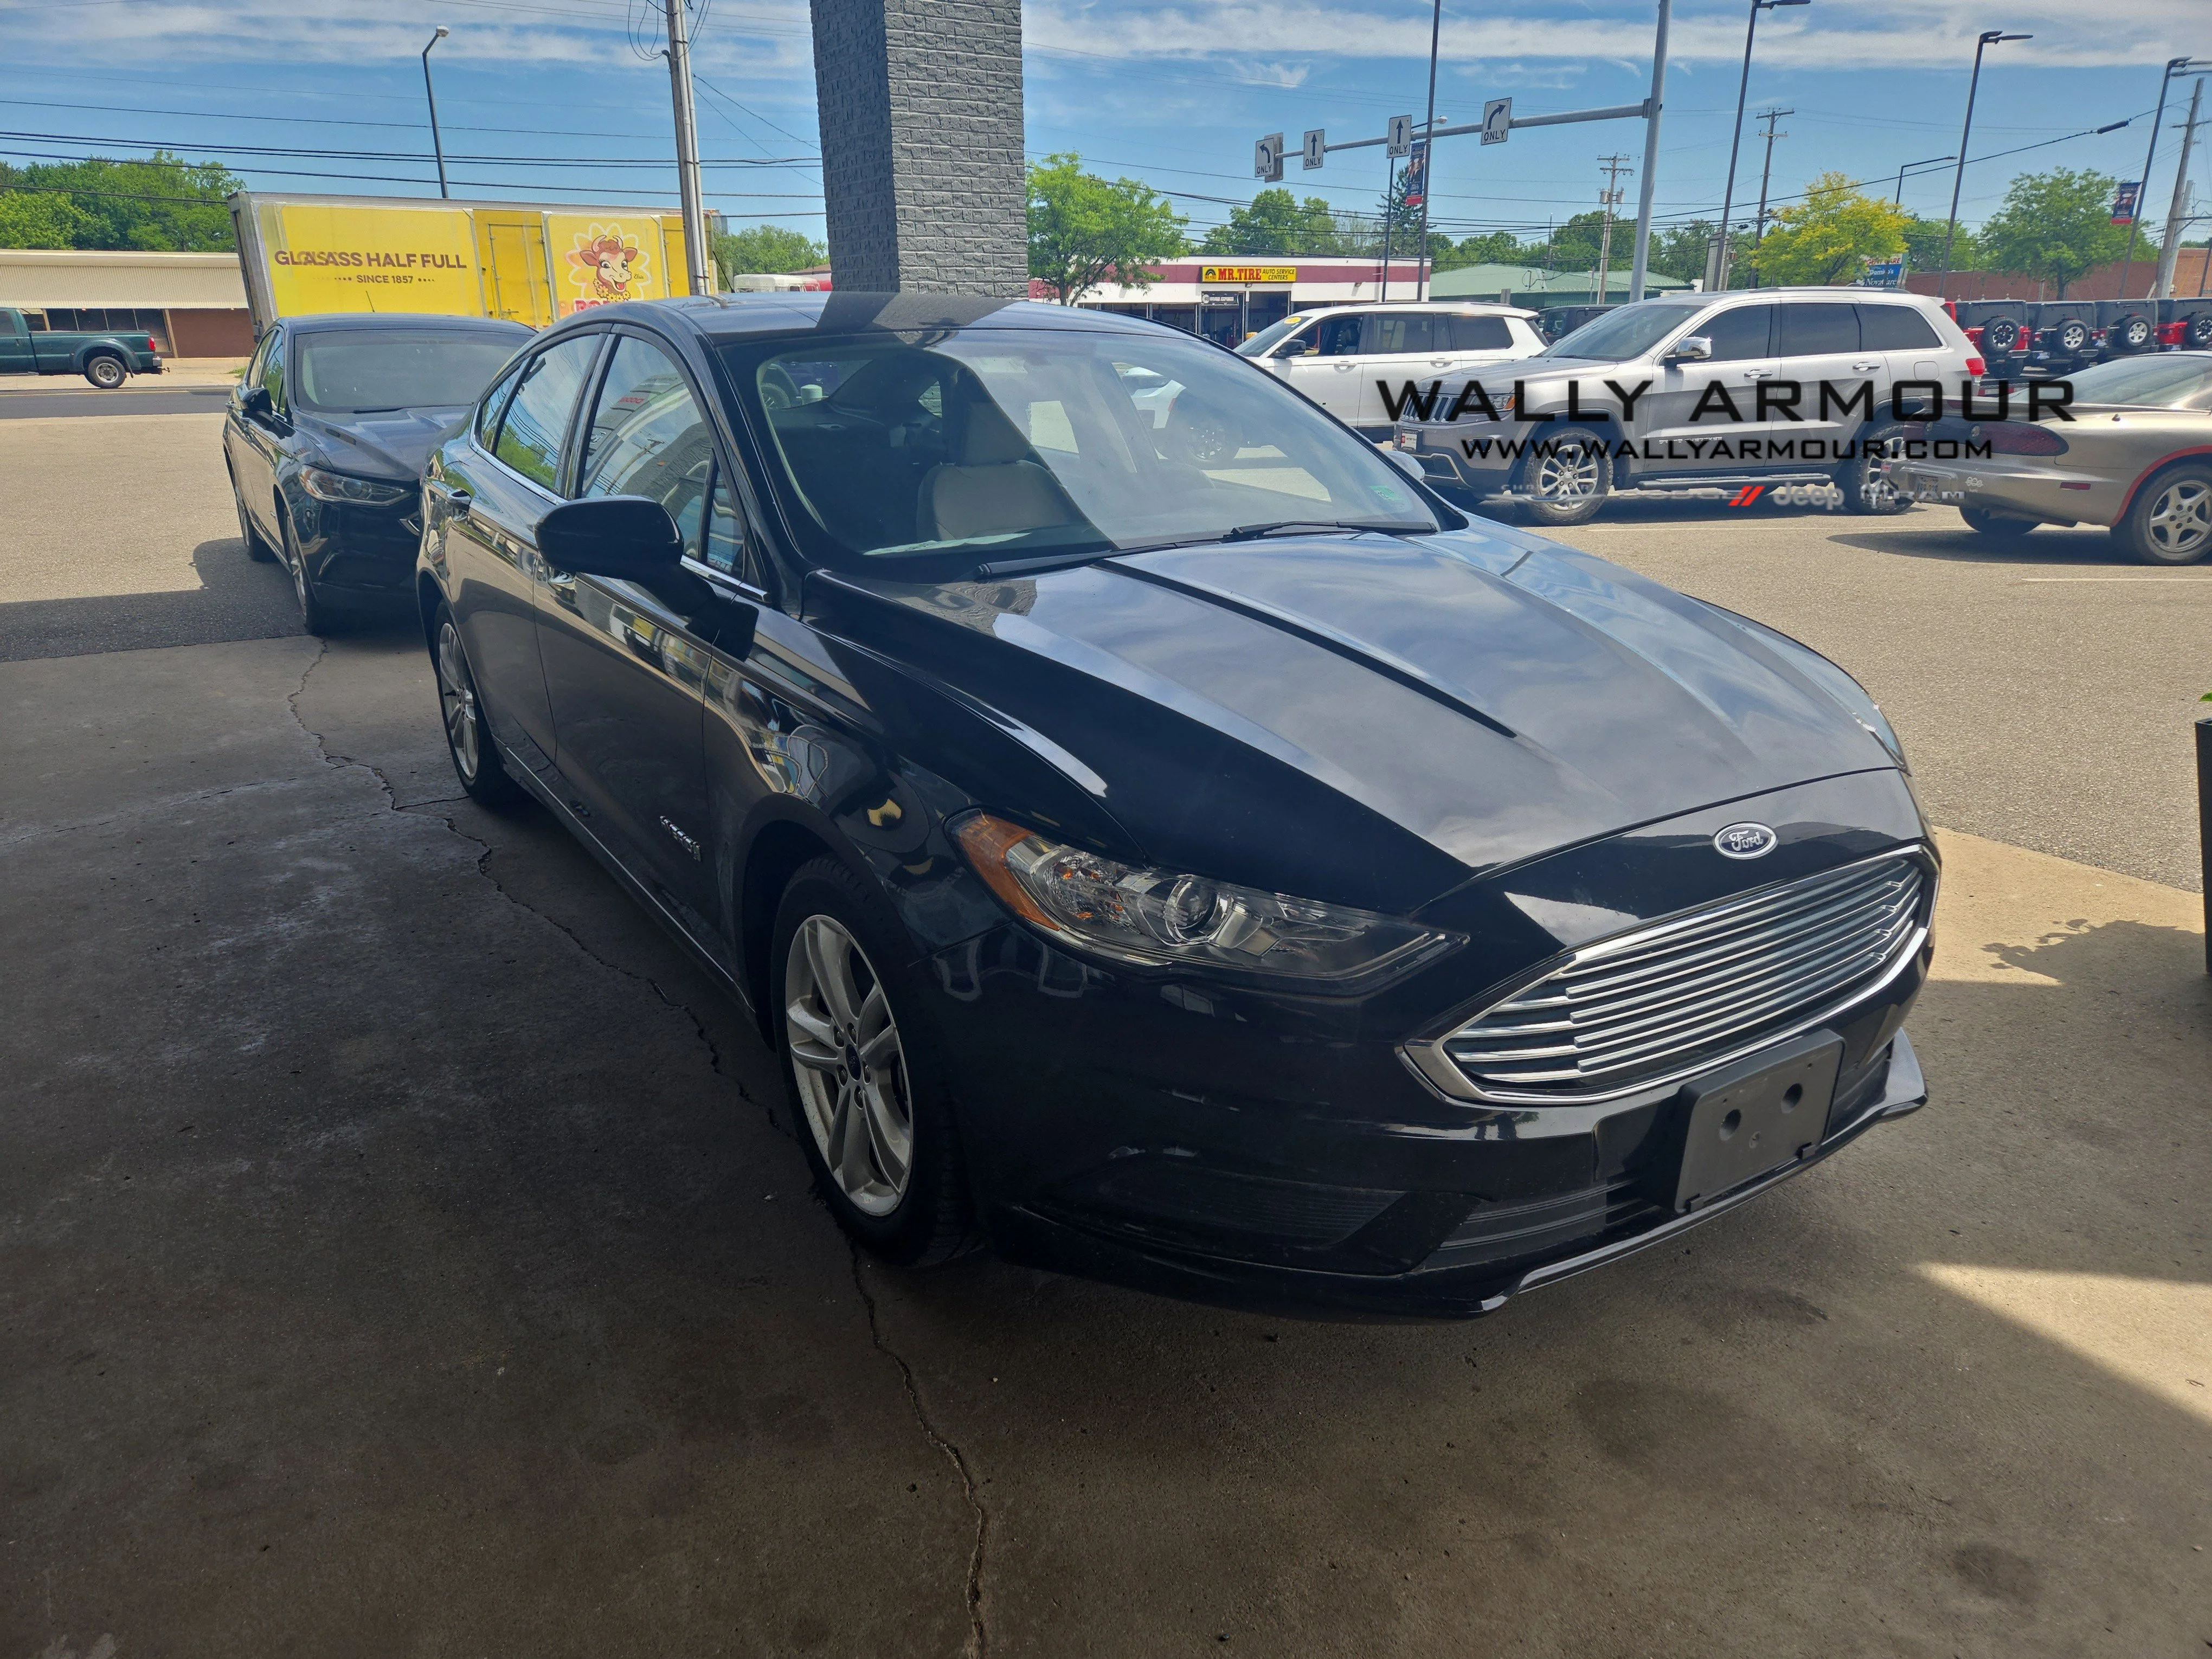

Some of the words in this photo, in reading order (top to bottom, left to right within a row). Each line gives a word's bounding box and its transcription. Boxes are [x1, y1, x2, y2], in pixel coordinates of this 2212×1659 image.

[1484, 129, 1506, 141] ONLY
[1389, 145, 1408, 155] ONLY
[1306, 157, 1321, 166] ONLY
[1257, 164, 1272, 174] ONLY
[366, 252, 417, 268] HALF
[420, 253, 467, 269] FULL
[356, 274, 390, 284] SINCE
[391, 275, 414, 284] 1857
[1728, 829, 1764, 852] Ford
